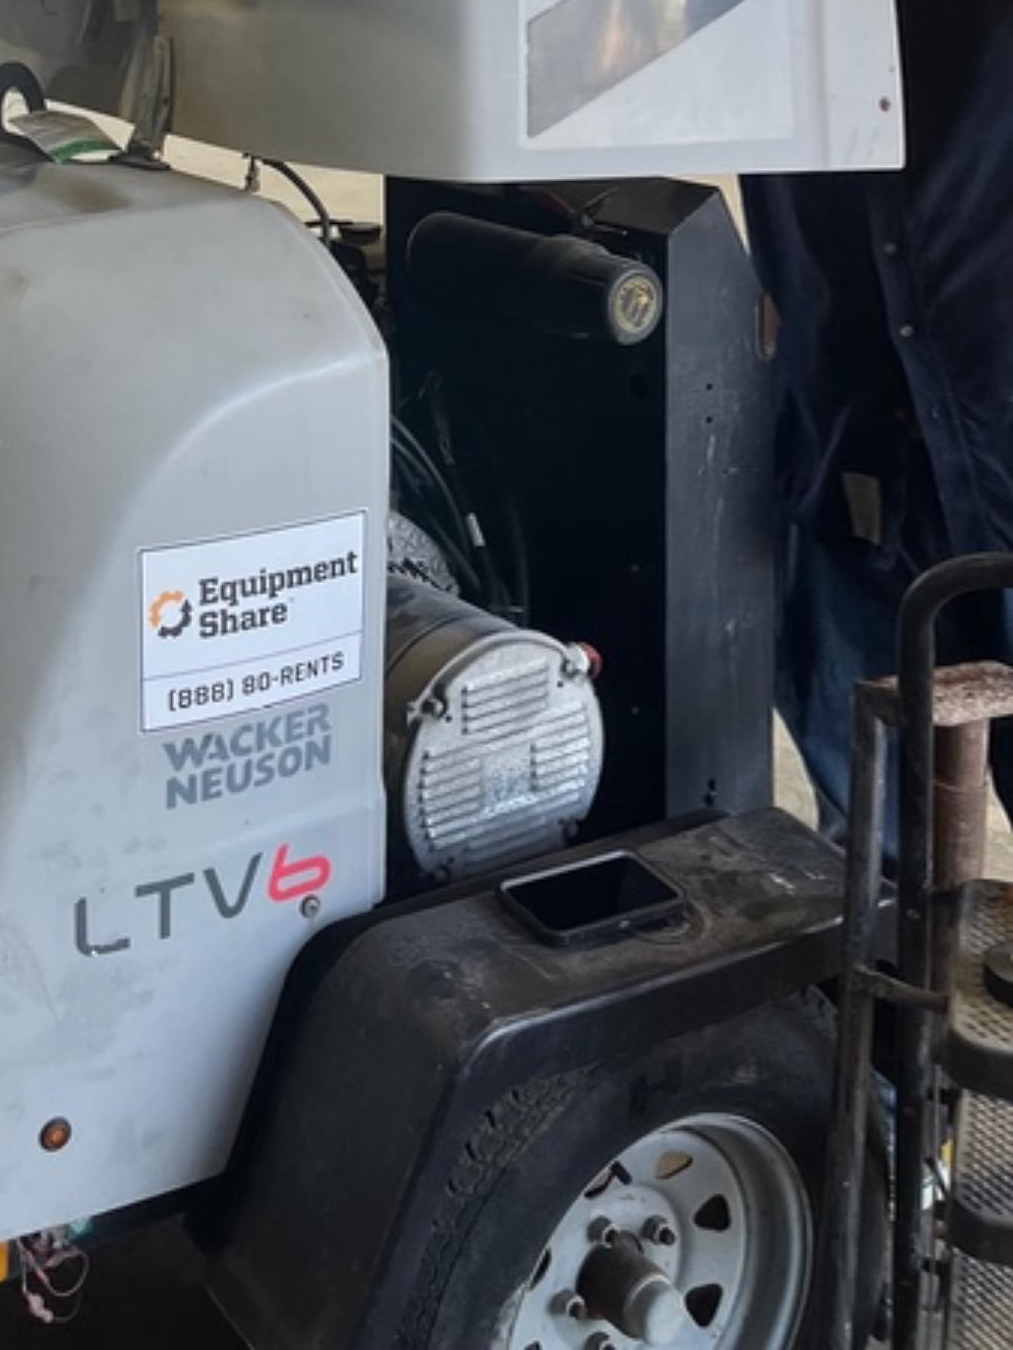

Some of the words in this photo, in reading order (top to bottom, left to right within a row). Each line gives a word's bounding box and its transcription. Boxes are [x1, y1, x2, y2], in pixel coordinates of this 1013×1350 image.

[198, 550, 358, 606] Equipment
[198, 601, 288, 639] Share
[168, 676, 234, 711] (888)
[243, 652, 345, 697] 80-RENTS
[162, 704, 332, 772] WACKER
[165, 735, 332, 810] NEUSON
